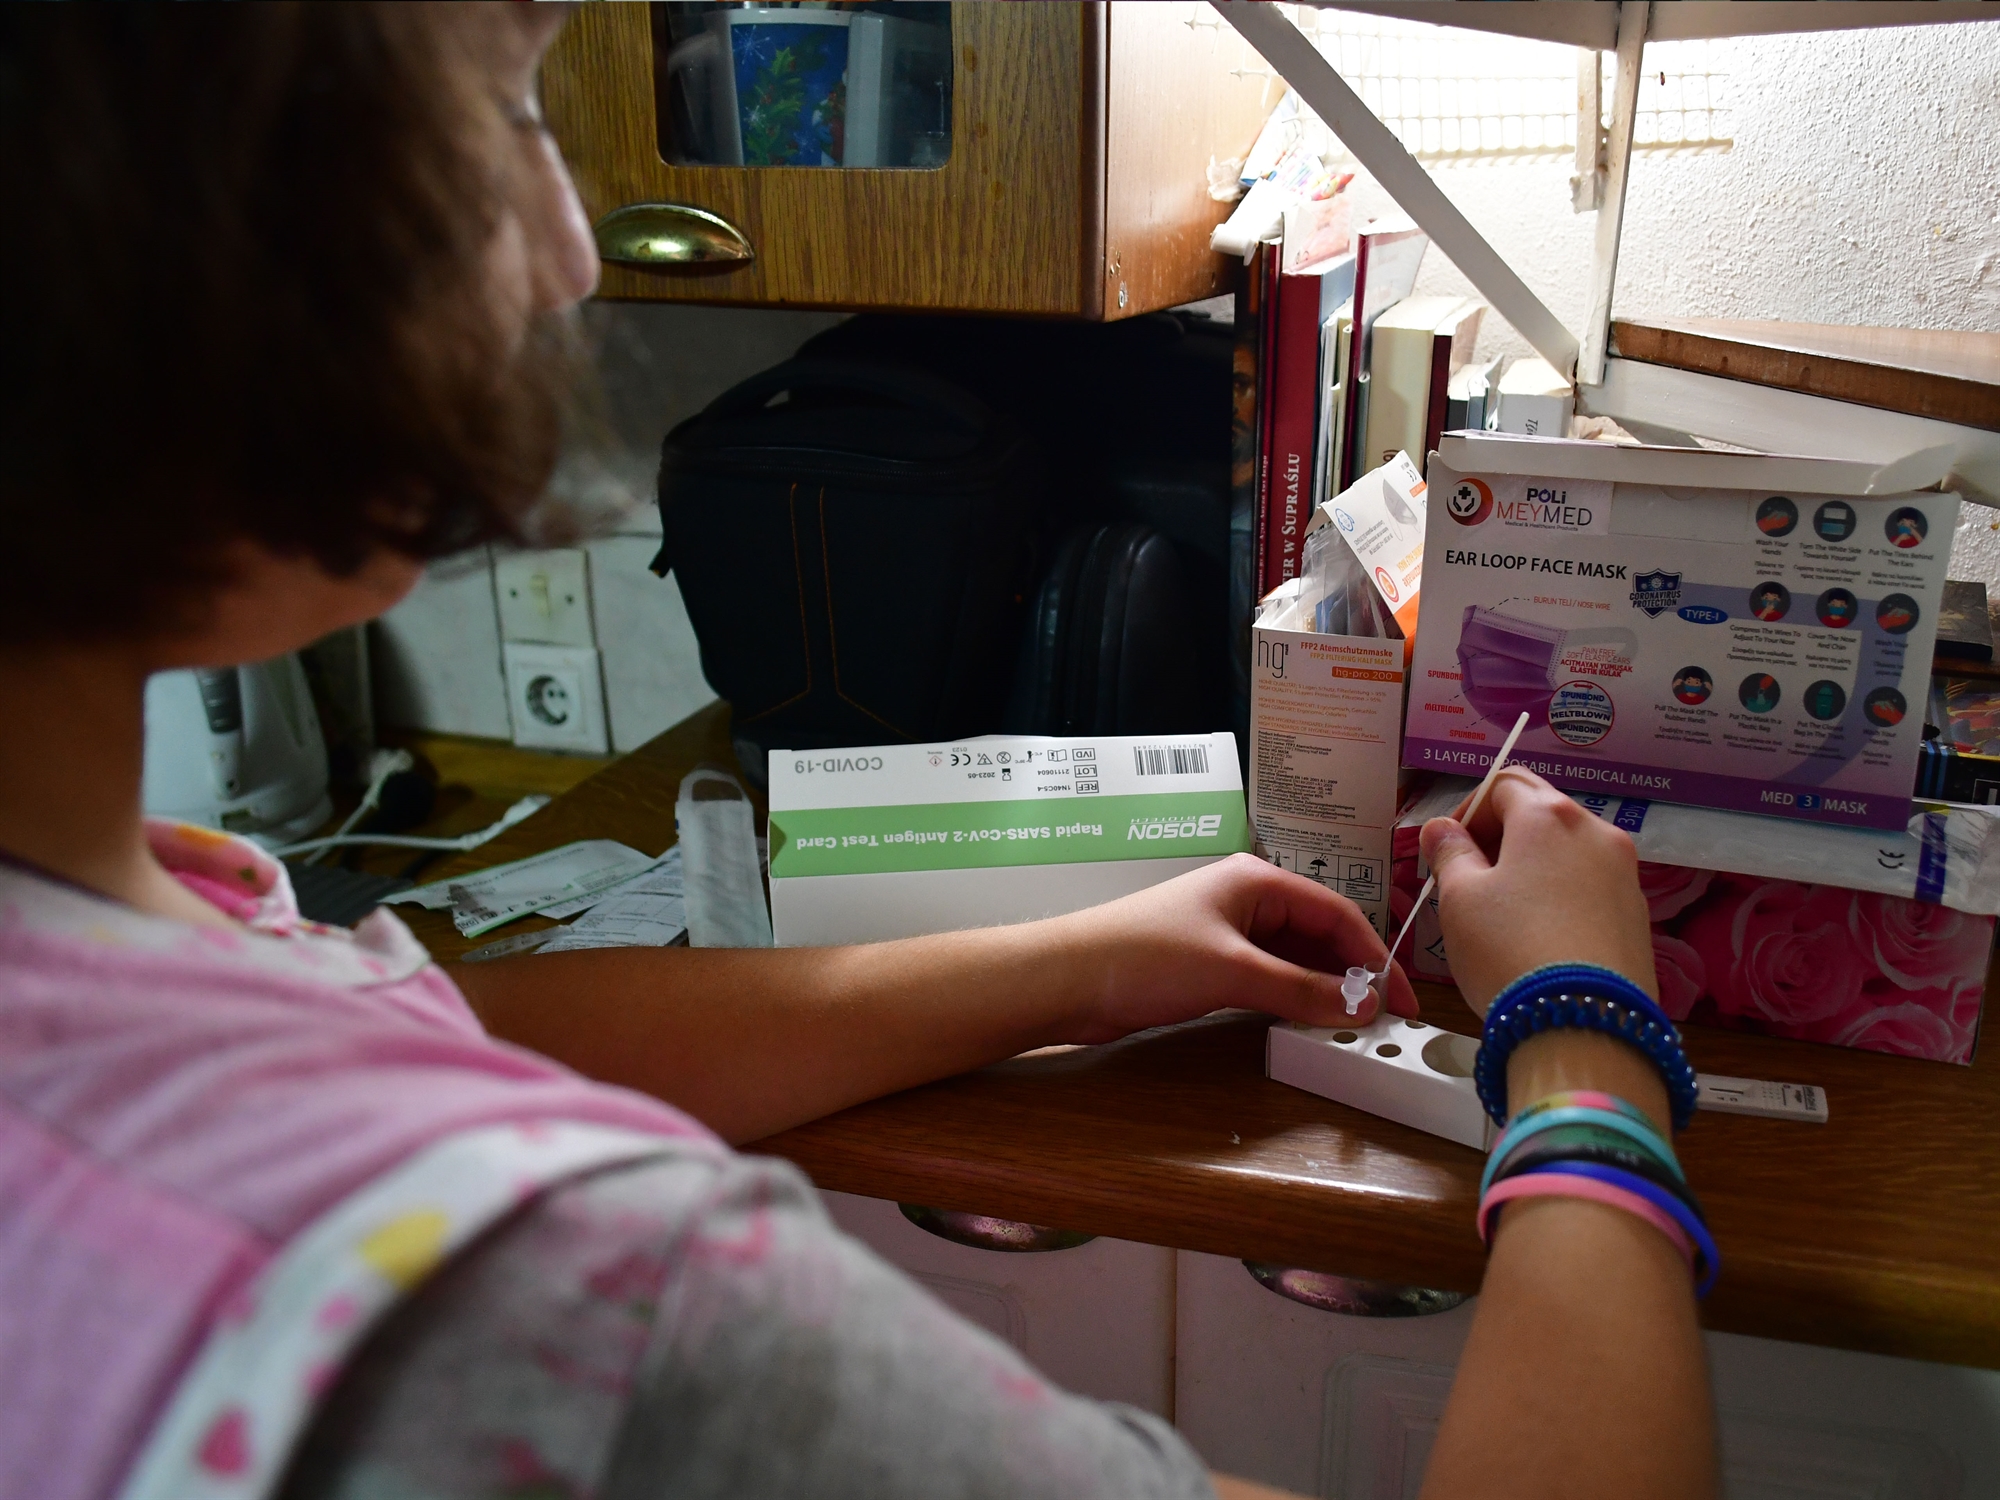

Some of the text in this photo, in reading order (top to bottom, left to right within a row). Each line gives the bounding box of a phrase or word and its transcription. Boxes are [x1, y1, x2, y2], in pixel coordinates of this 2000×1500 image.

[1497, 501, 1592, 526] MEYMED
[1446, 550, 1627, 580] EAR LOOP FACE MASK
[1630, 590, 1682, 601] CORONAVIRUS
[1577, 599, 1595, 609] NOSE
[1596, 602, 1611, 610] WIRE
[1632, 597, 1677, 608] PROTECTION
[1685, 609, 1720, 621] TYPE-I
[1730, 624, 1760, 635] Compress
[1775, 628, 1792, 637] Wires
[1734, 633, 1753, 642] Adjust
[1779, 637, 1795, 645] Nose
[1807, 632, 1826, 640] Cover
[1840, 635, 1856, 643] Nose
[1300, 642, 1318, 651] FFP2
[1582, 646, 1616, 657] PAIN FREE
[1258, 631, 1284, 679] hg
[1326, 654, 1356, 662] FILTERING
[1358, 656, 1373, 664] HALF
[1374, 657, 1392, 666] MASK
[1566, 651, 1631, 665] SOFT ELASTIC EARS
[1336, 668, 1393, 680] hg-pro 200
[1427, 669, 1464, 682] SPUNBOND
[1599, 668, 1622, 678] KULAK
[1560, 691, 1605, 702] SPUNBOND
[1424, 702, 1464, 715] MELTBLOWN
[1550, 710, 1611, 722] MELTBLOWN
[1665, 714, 1687, 722] Rubber
[1449, 729, 1486, 741] SPUNBOND
[1557, 723, 1602, 735] SPUNBOND
[1076, 750, 1093, 759] IVD
[794, 756, 883, 774] COVID-19
[1423, 748, 1672, 790] 3 LAYER DIPOSABLE MEDICAL MASK
[1075, 767, 1096, 776] LOT
[1078, 782, 1097, 792] REF
[1760, 790, 1867, 816] MED 3 MASK
[1127, 814, 1222, 841] BOSON
[796, 823, 1103, 850] Rapid SARS-CoV-2 Antigen Test Card
